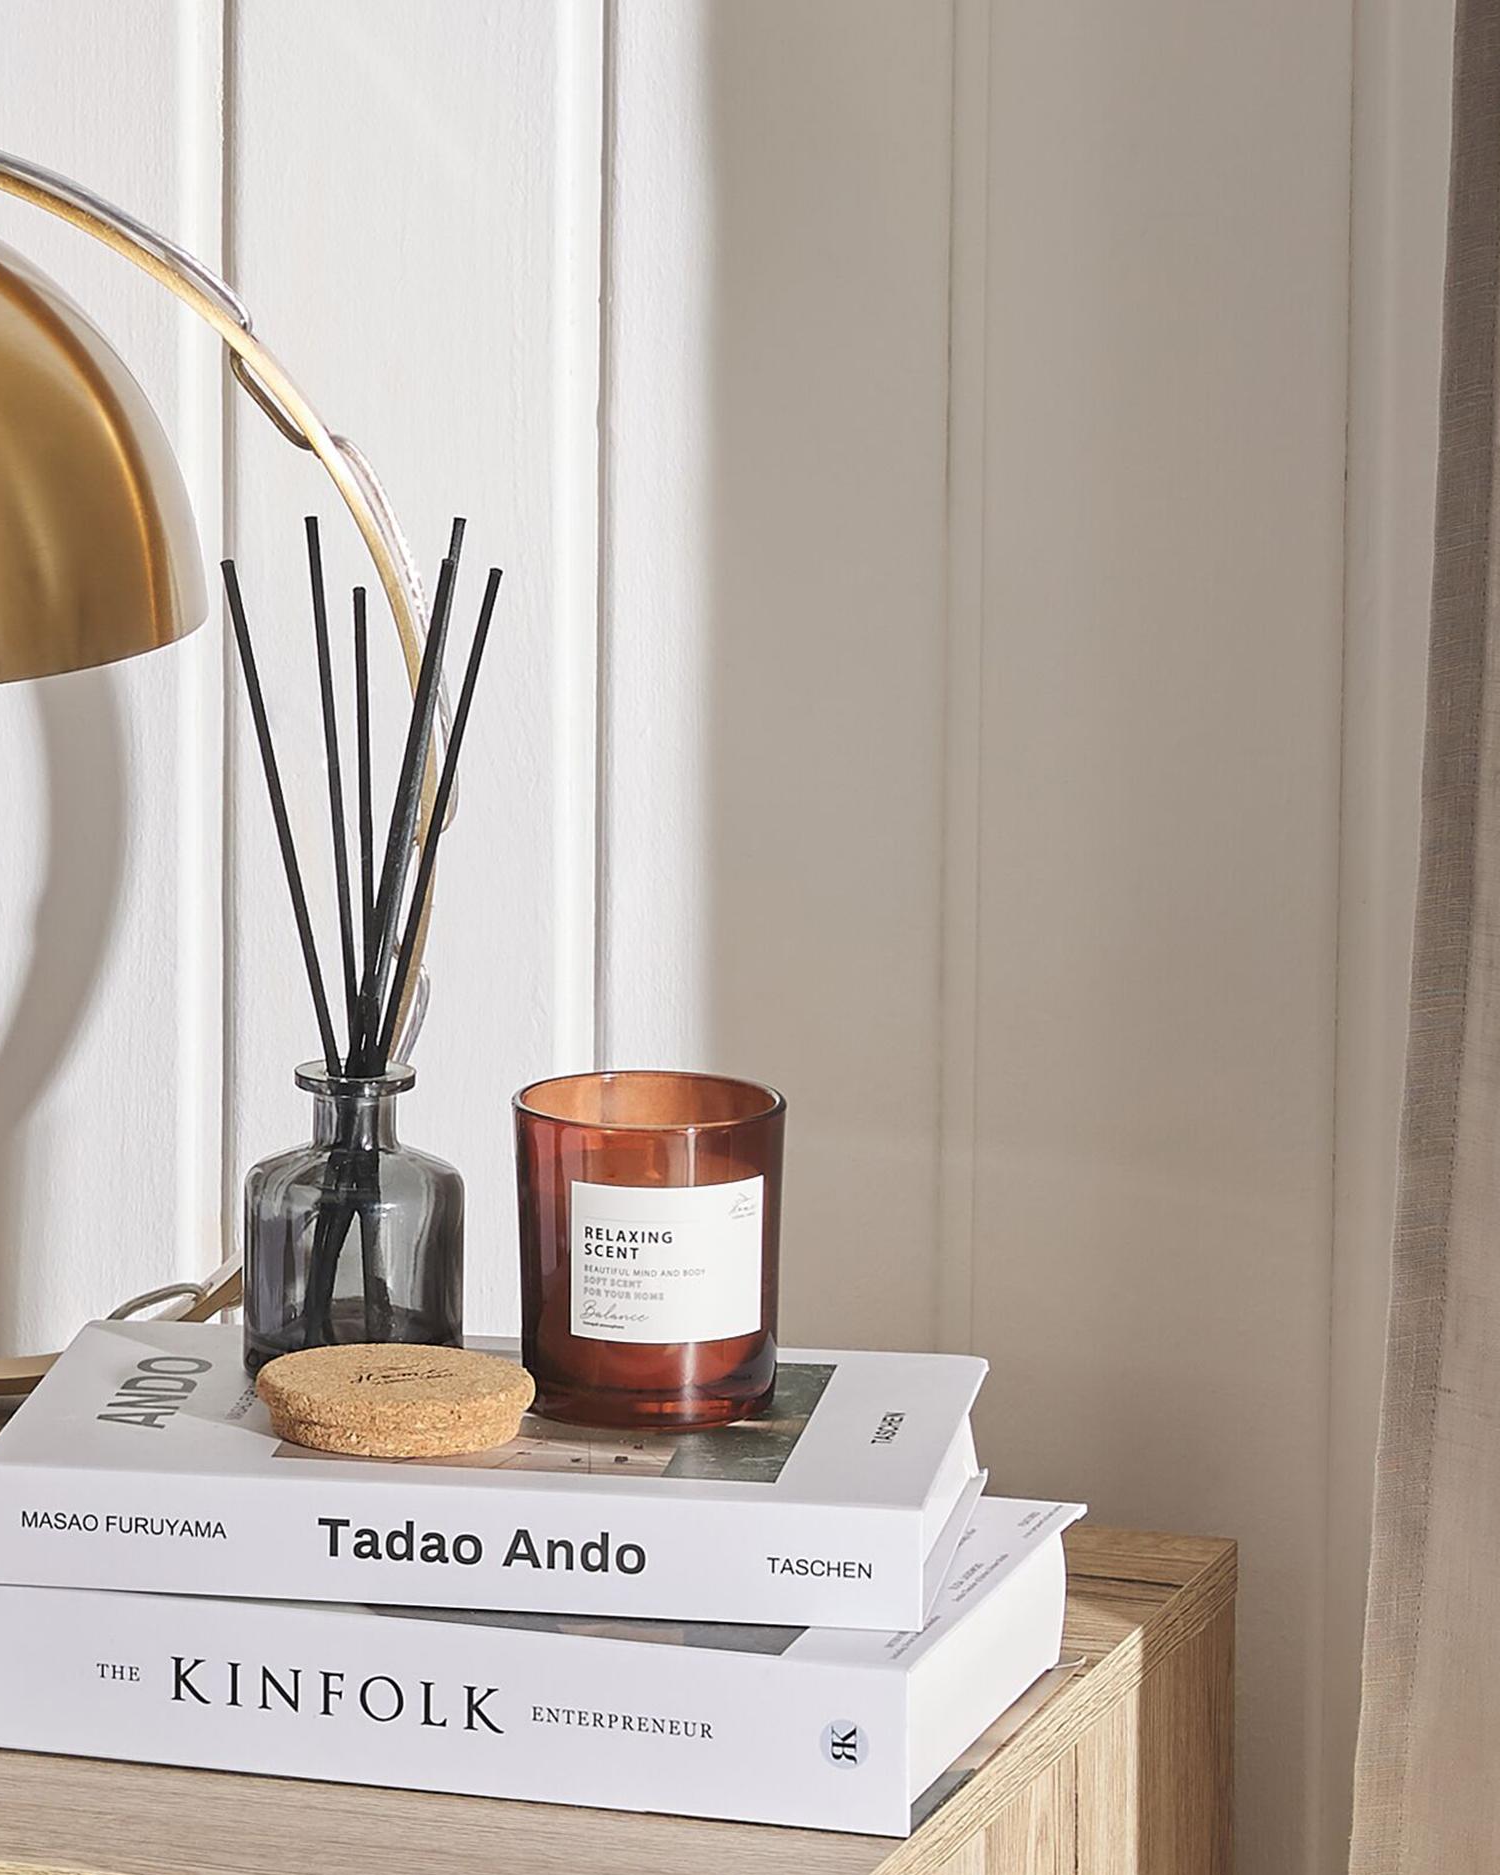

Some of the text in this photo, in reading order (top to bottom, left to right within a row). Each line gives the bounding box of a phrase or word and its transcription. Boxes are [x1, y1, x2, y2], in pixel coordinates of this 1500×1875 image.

[584, 1226, 673, 1244] RELAXING
[584, 1243, 639, 1260] SCENT
[583, 1264, 630, 1277] BEAUTIFUL
[633, 1269, 658, 1278] MIND
[661, 1269, 681, 1278] AND
[583, 1286, 665, 1301] FOR YOUR HOME
[610, 1278, 643, 1289] SCENT
[96, 1356, 212, 1429] ANDO
[871, 1411, 906, 1444] TASCHEN
[21, 1511, 227, 1540] MASAO FURUYAMA
[318, 1518, 647, 1575] Tadao Ando
[767, 1557, 873, 1580] TASCHEN
[97, 1656, 714, 1740] THE KINFOLK ENTERPRENEUR
